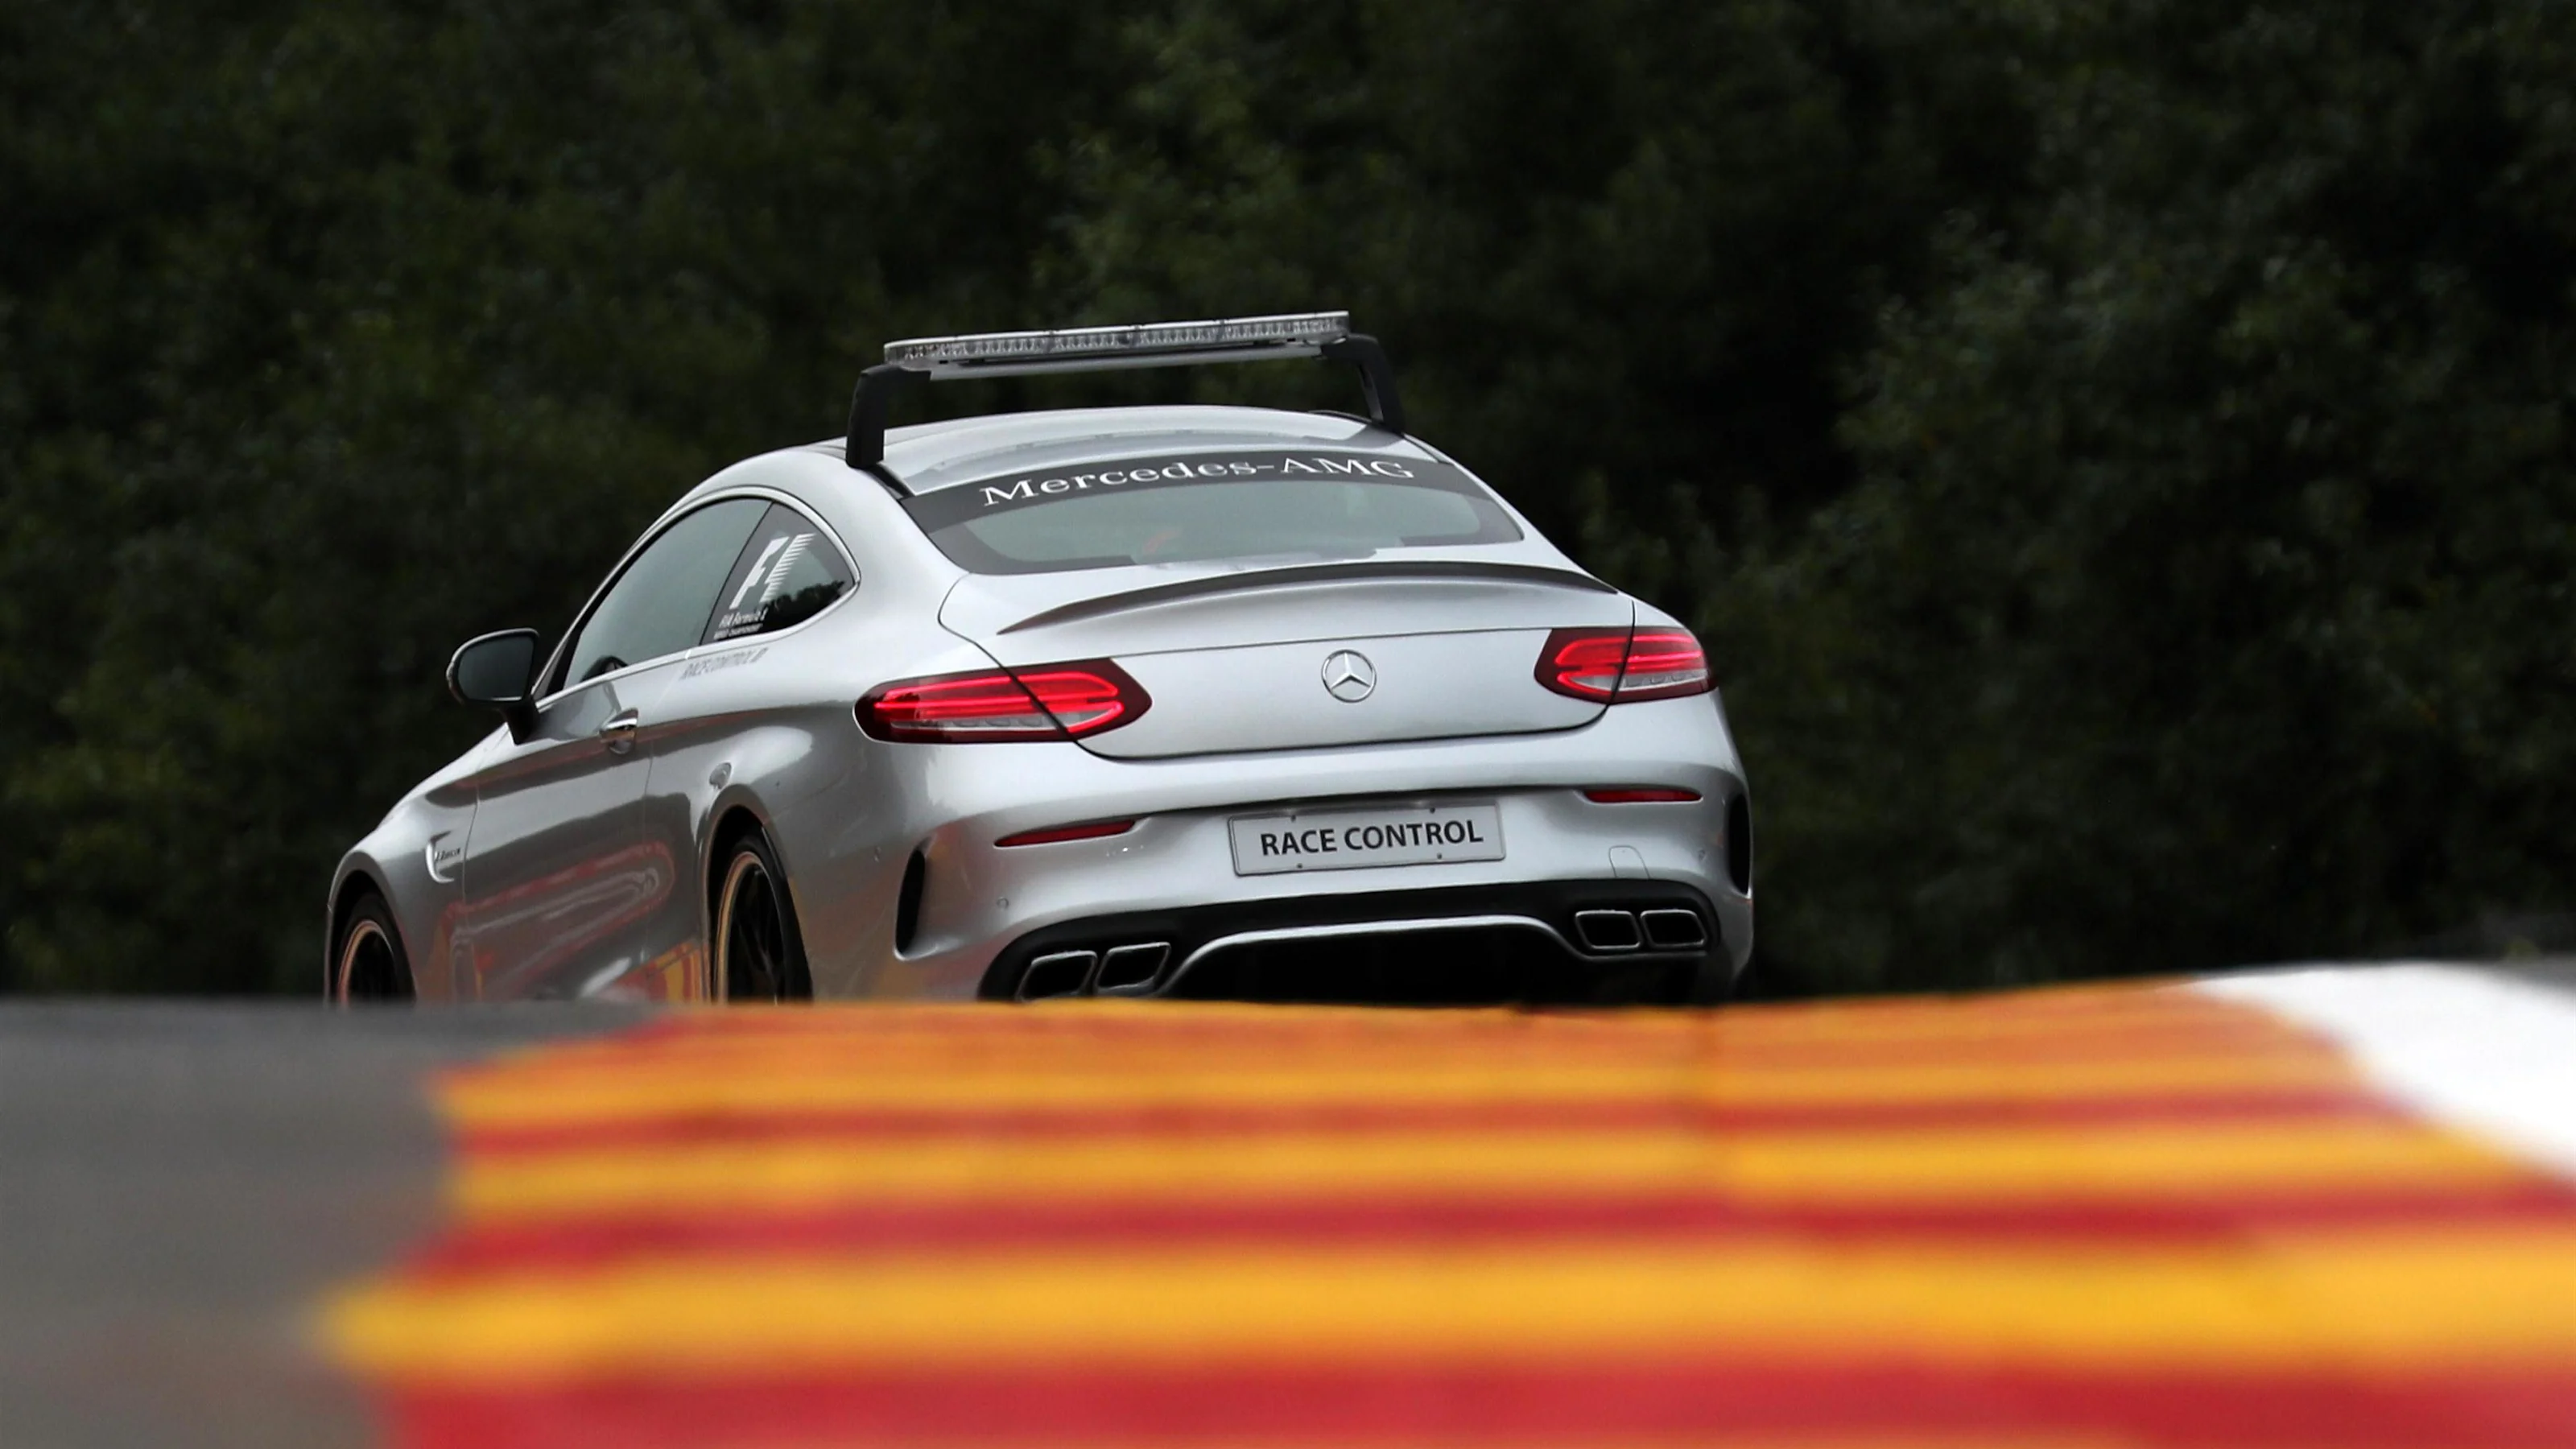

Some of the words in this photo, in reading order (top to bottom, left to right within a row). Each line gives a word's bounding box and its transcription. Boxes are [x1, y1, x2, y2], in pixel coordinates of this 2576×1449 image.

[980, 456, 1414, 506] Mercedes-AMG
[1260, 828, 1337, 856] RACE
[1344, 819, 1483, 850] CONTROL
